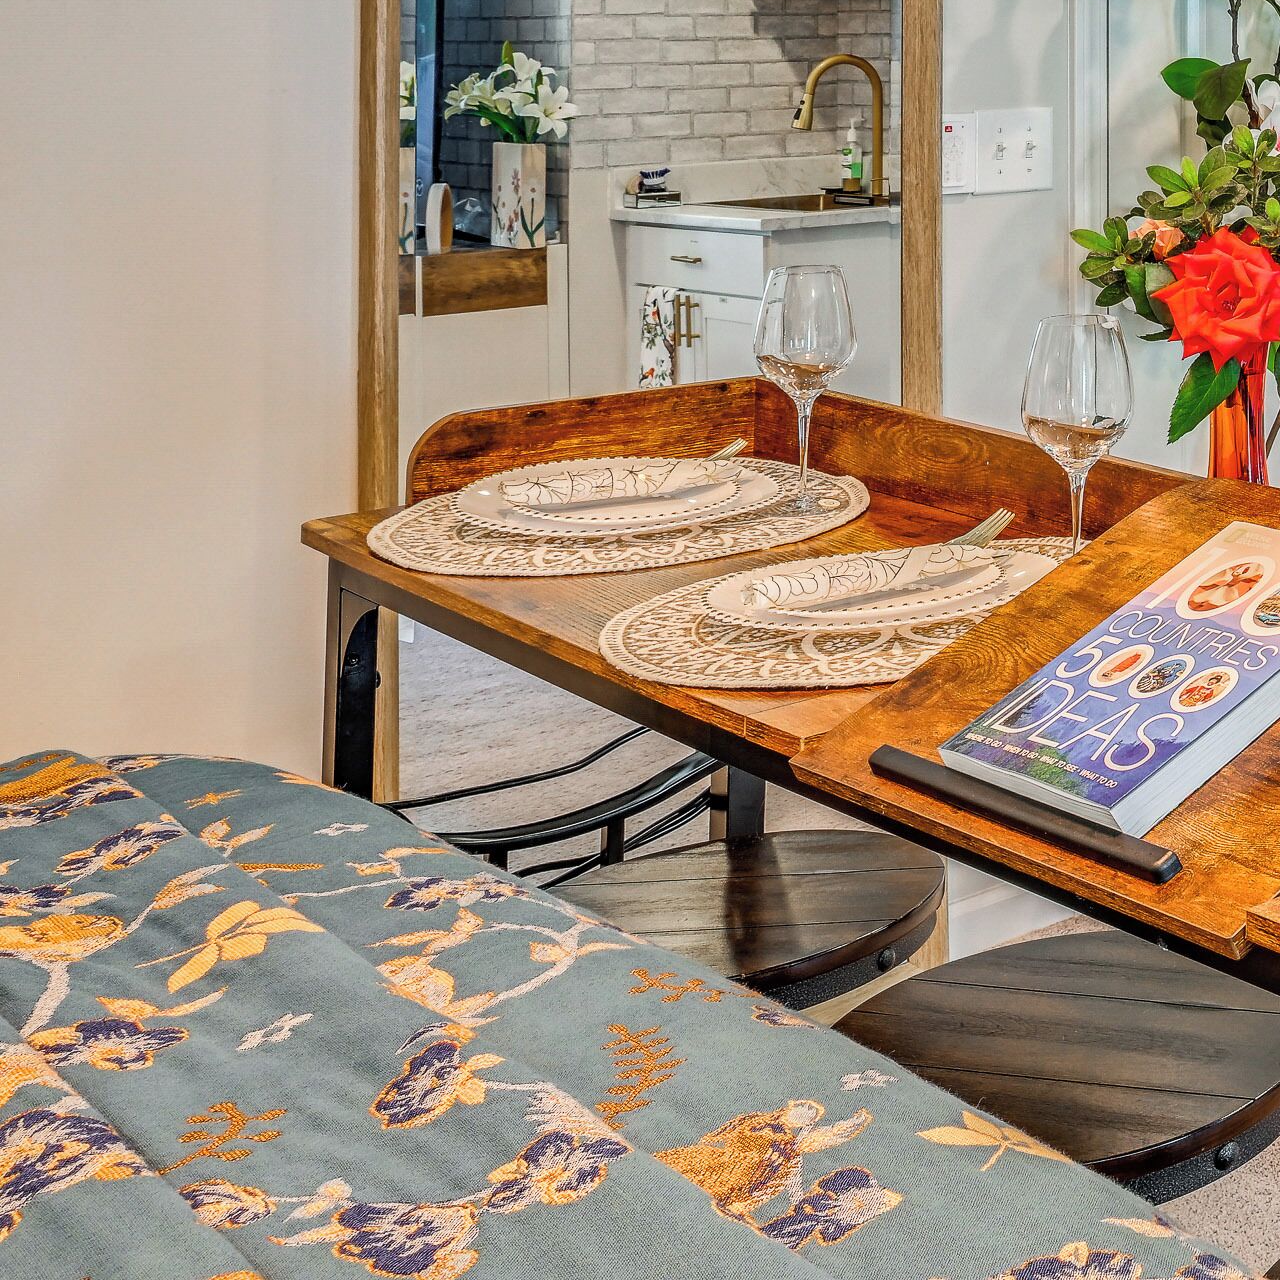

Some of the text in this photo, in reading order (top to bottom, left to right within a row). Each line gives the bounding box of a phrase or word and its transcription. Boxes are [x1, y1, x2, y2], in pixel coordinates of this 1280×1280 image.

[1055, 634, 1240, 714] 5000
[1108, 610, 1279, 672] COUNTRIES
[964, 732, 986, 743] WHERE
[1003, 744, 1022, 754] WHEN
[1039, 755, 1058, 765] WHAT
[1064, 764, 1079, 773] SEE
[1079, 769, 1098, 781] WHAT
[1105, 779, 1118, 788] DO
[982, 678, 1185, 773] IDEAS
